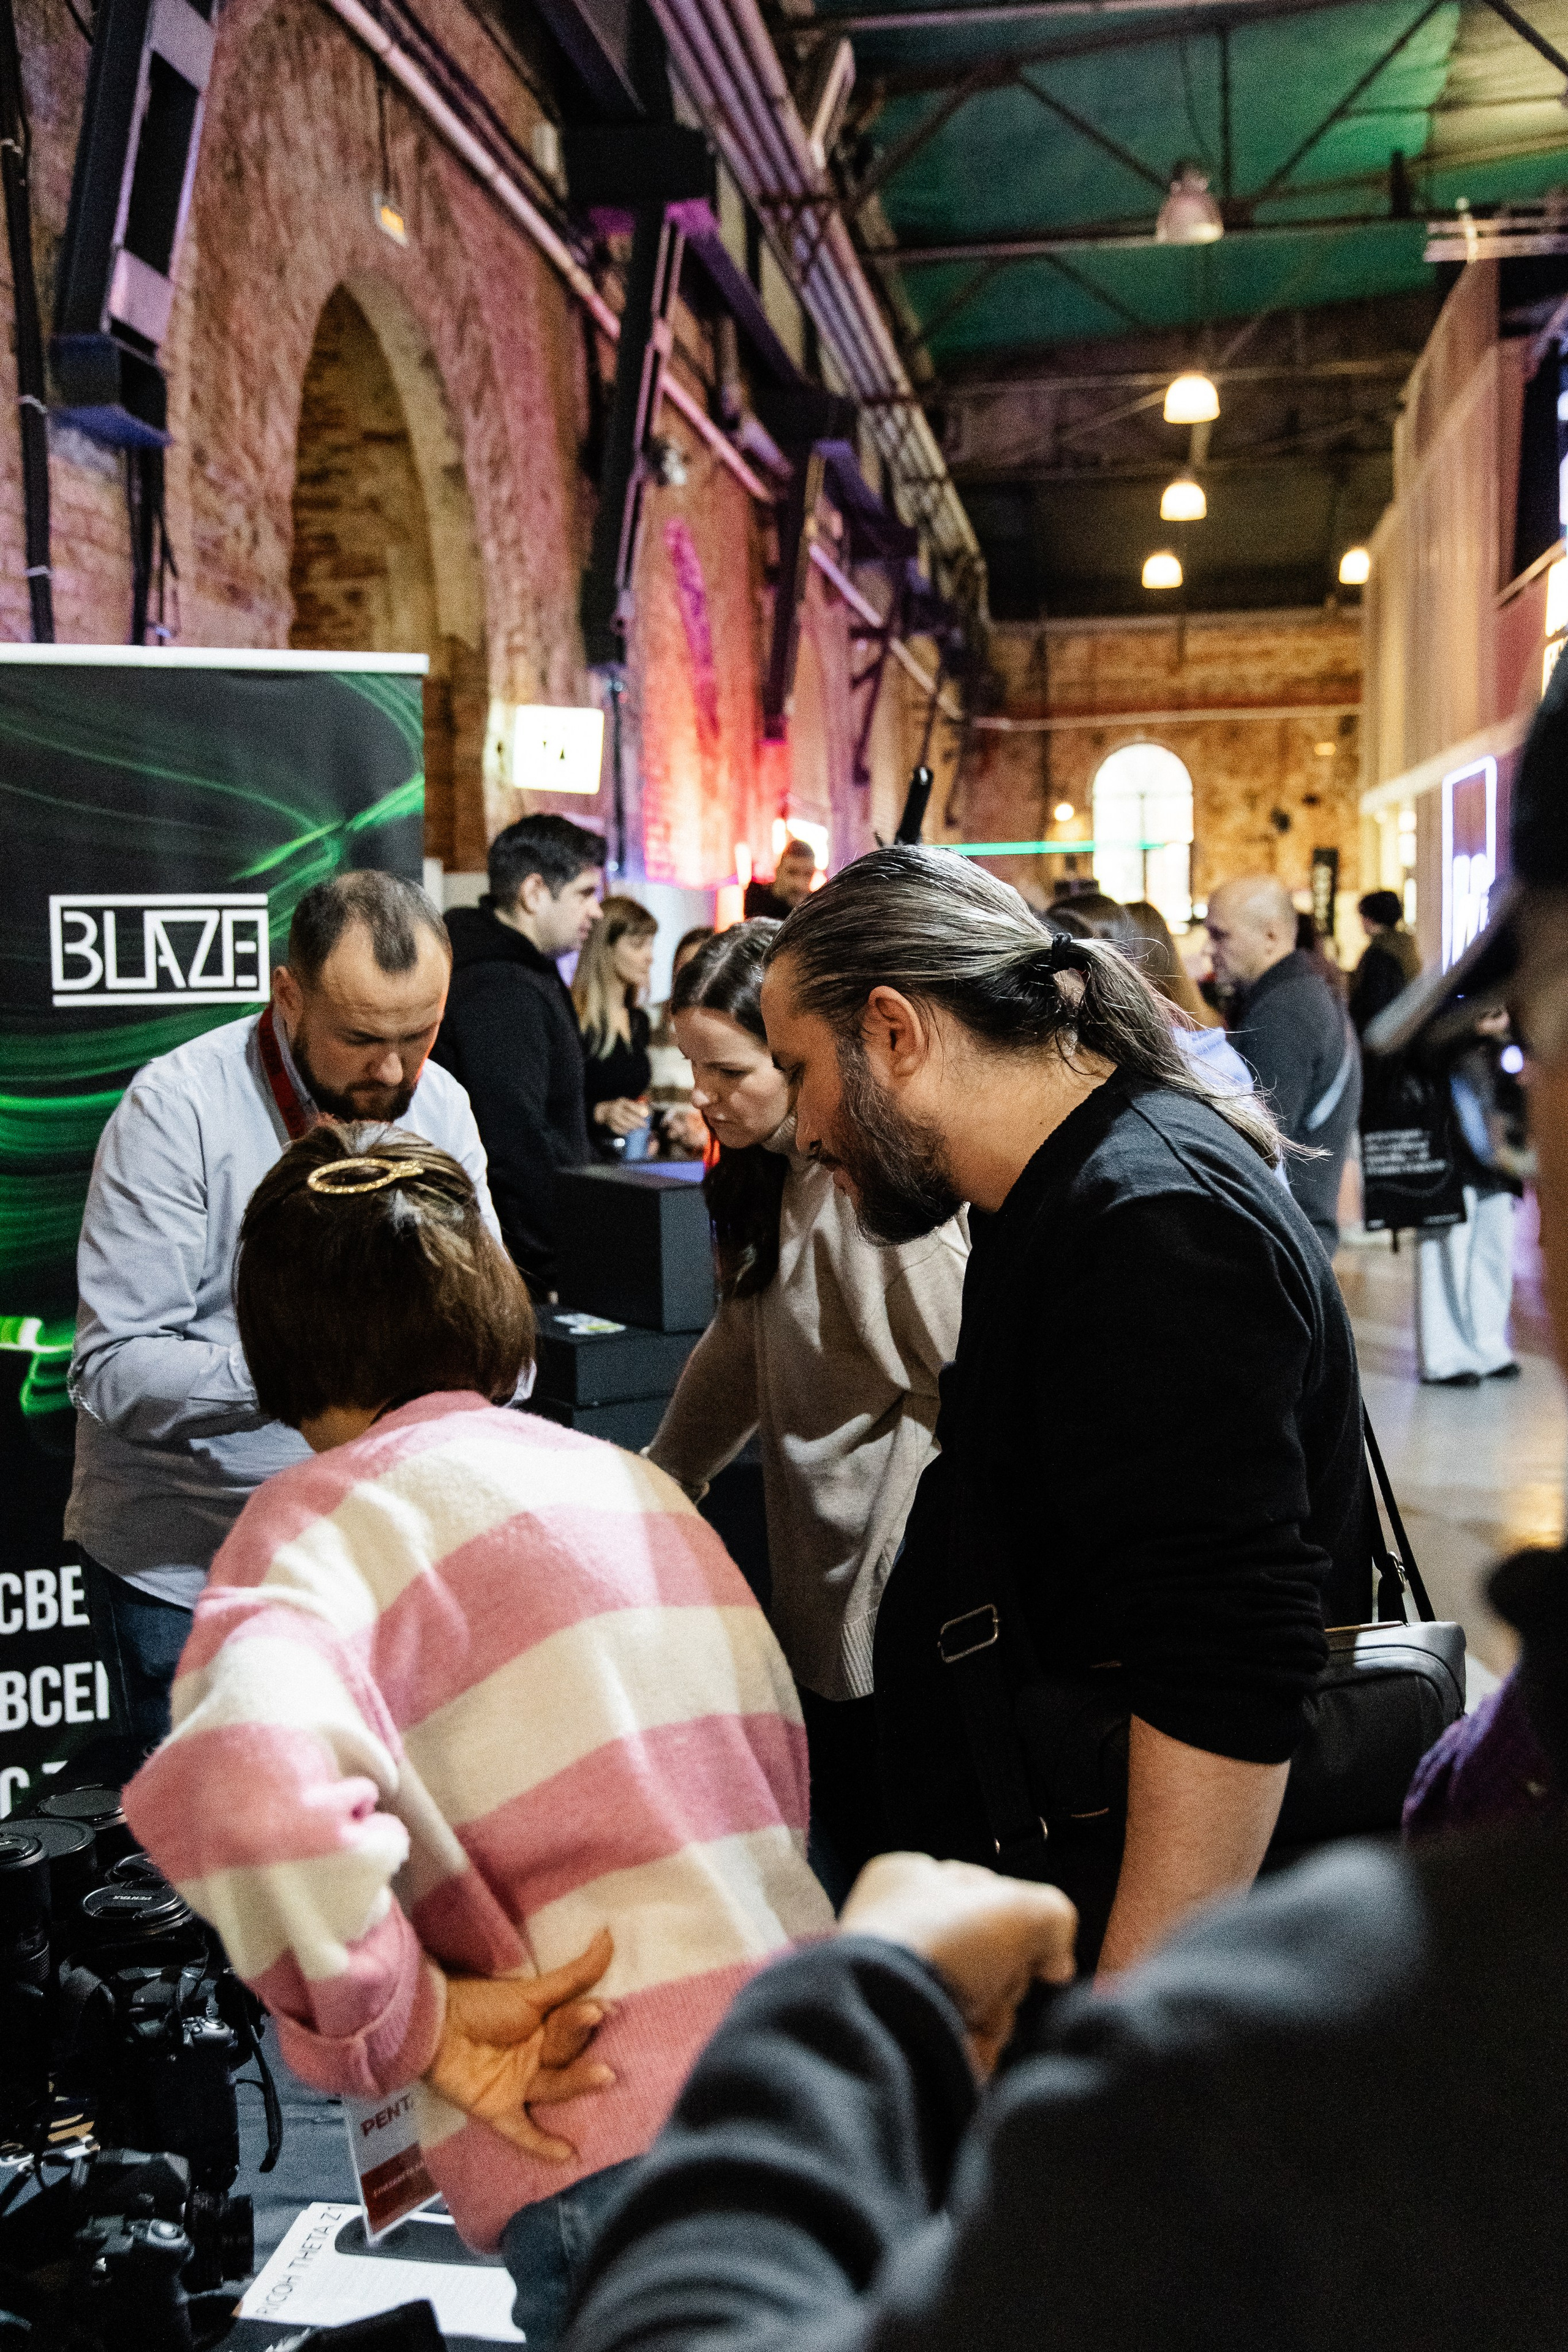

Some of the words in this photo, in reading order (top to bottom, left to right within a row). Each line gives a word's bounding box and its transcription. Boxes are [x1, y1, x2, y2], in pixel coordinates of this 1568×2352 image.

[50, 894, 270, 1006] BLAZE
[360, 2094, 414, 2136] PENT
[255, 2274, 302, 2315] RICOH
[288, 2225, 334, 2269] THETA
